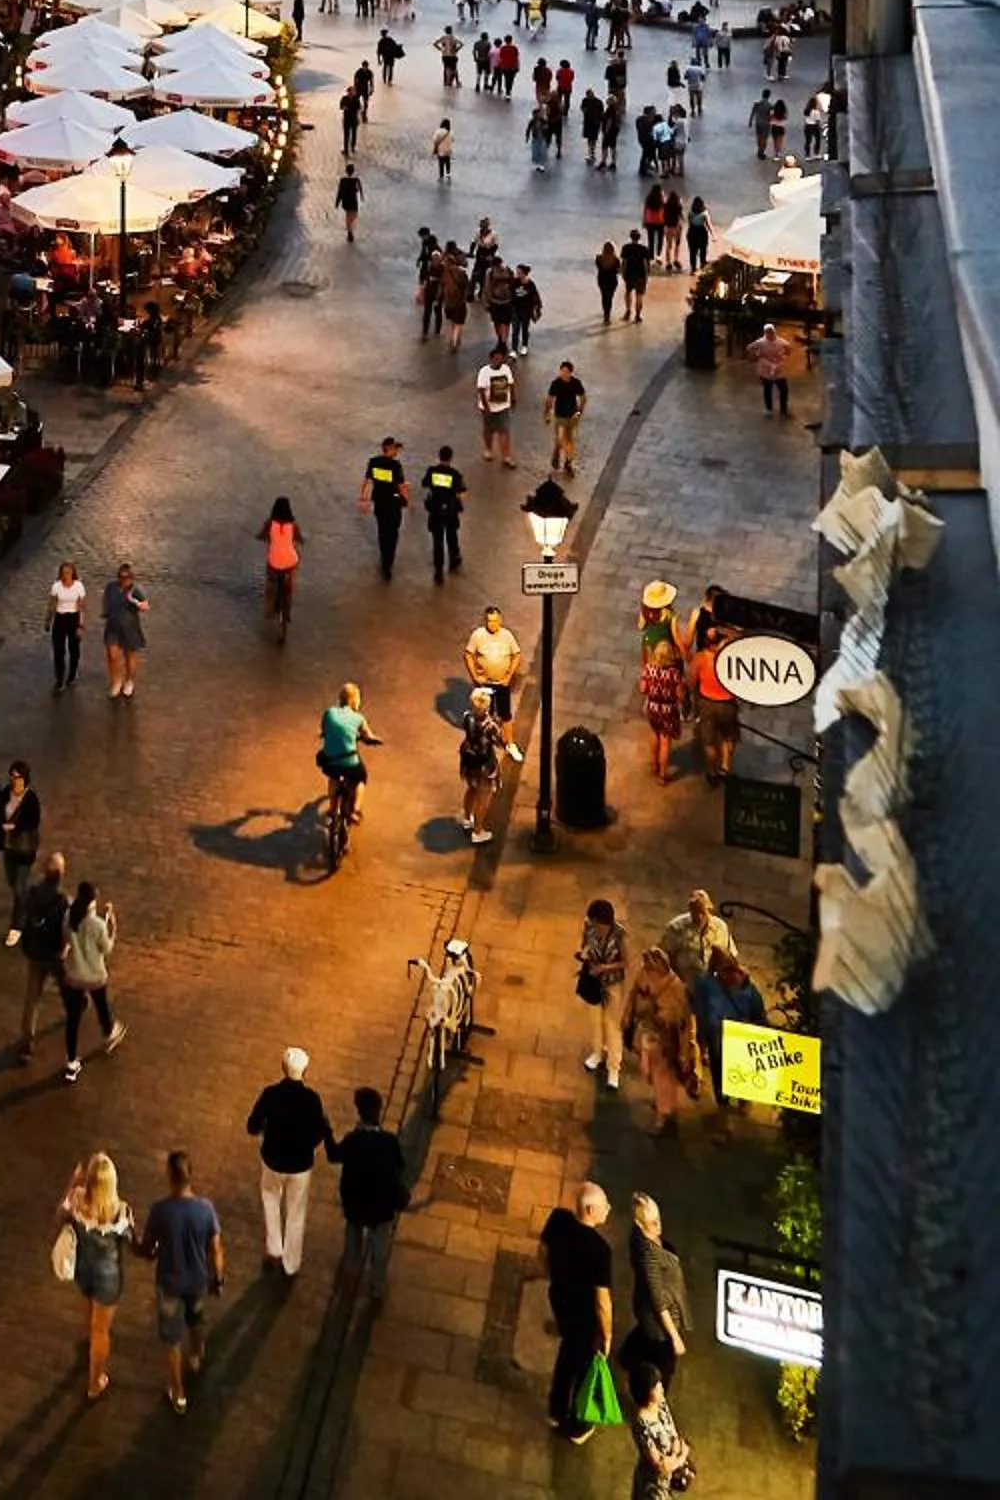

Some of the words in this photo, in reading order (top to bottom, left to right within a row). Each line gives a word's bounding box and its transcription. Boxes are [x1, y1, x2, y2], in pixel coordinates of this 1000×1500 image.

[727, 655, 804, 685] INNA
[747, 1035, 785, 1057] Rent
[767, 1051, 805, 1069] Bike
